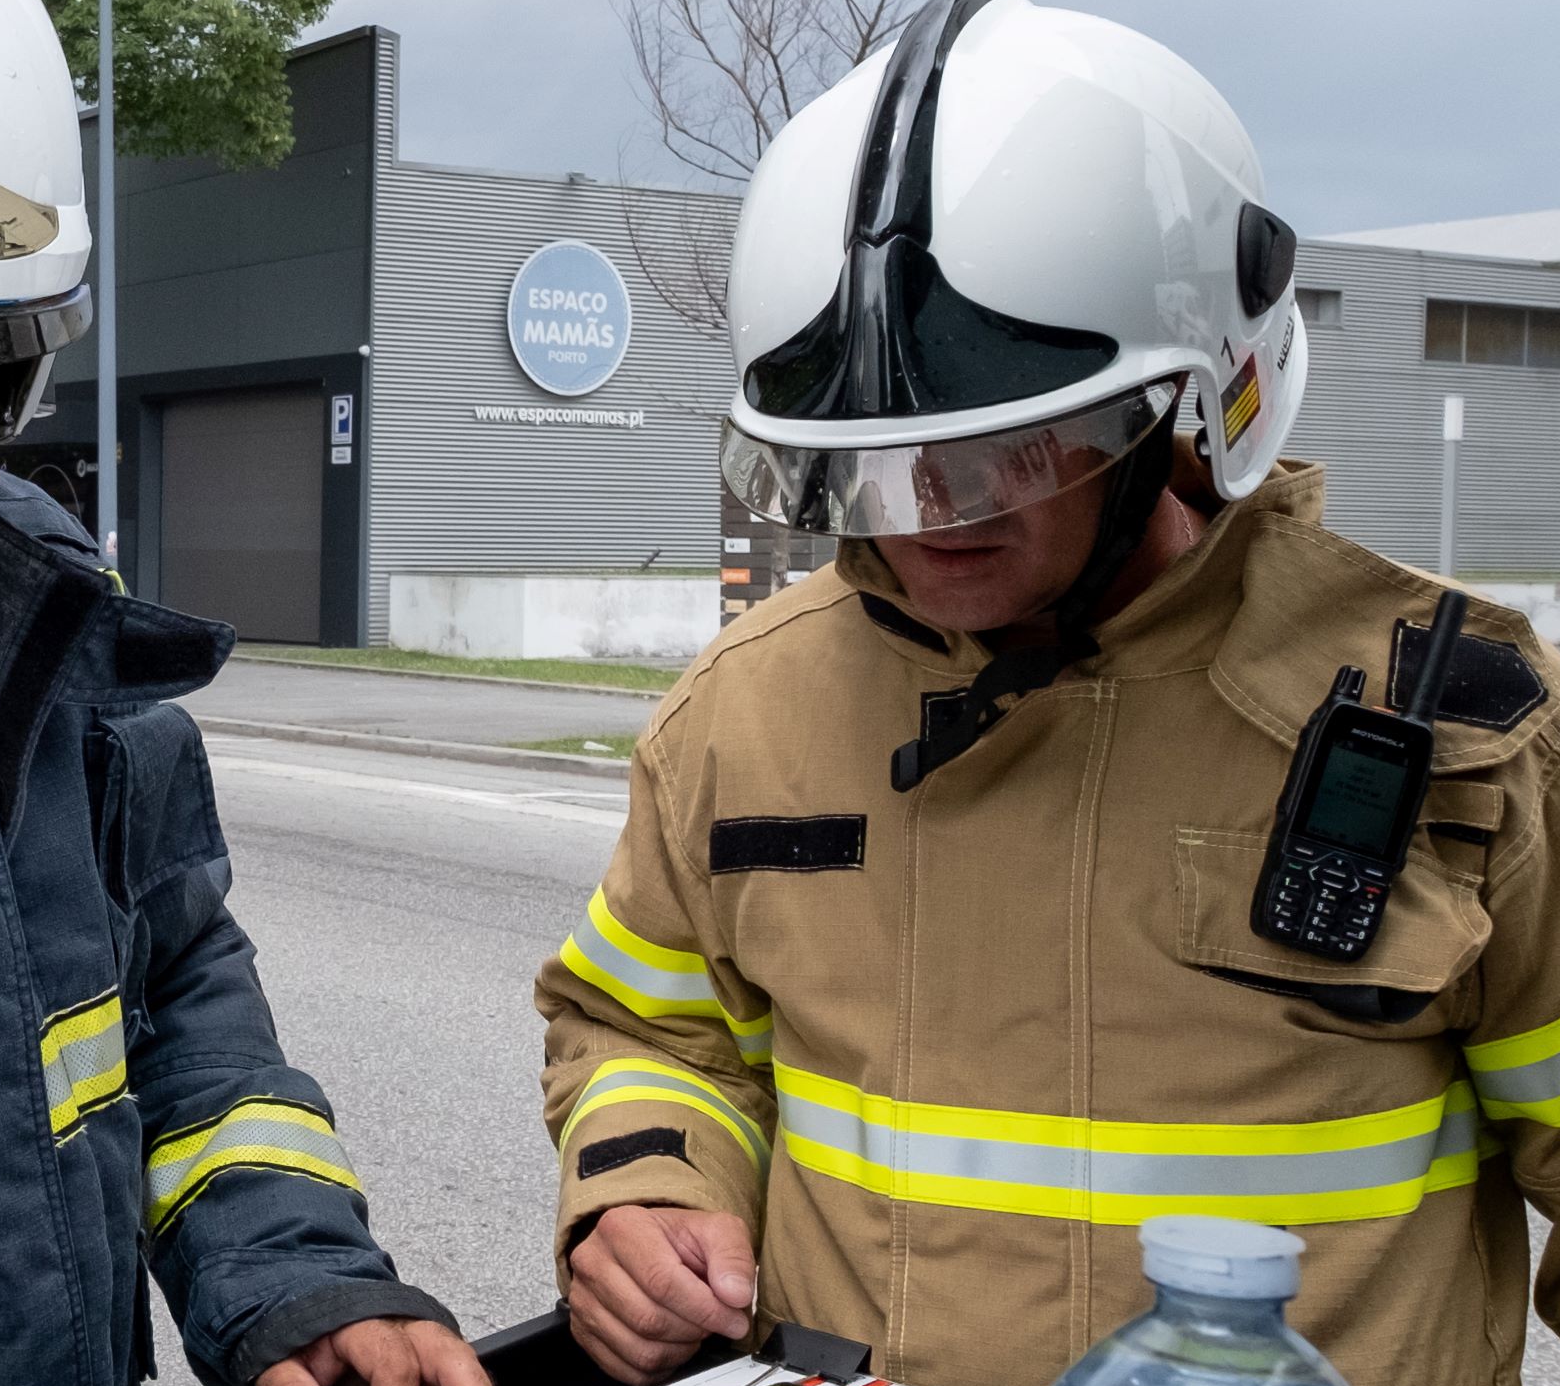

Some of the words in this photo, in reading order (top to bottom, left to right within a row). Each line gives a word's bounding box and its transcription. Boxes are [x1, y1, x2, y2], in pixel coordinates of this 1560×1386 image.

[529, 288, 607, 315] ESPAÇO
[523, 317, 615, 348] MAMÃS
[548, 351, 587, 364] PORTO
[335, 400, 349, 433] P
[1351, 728, 1405, 749] MOTOROLA
